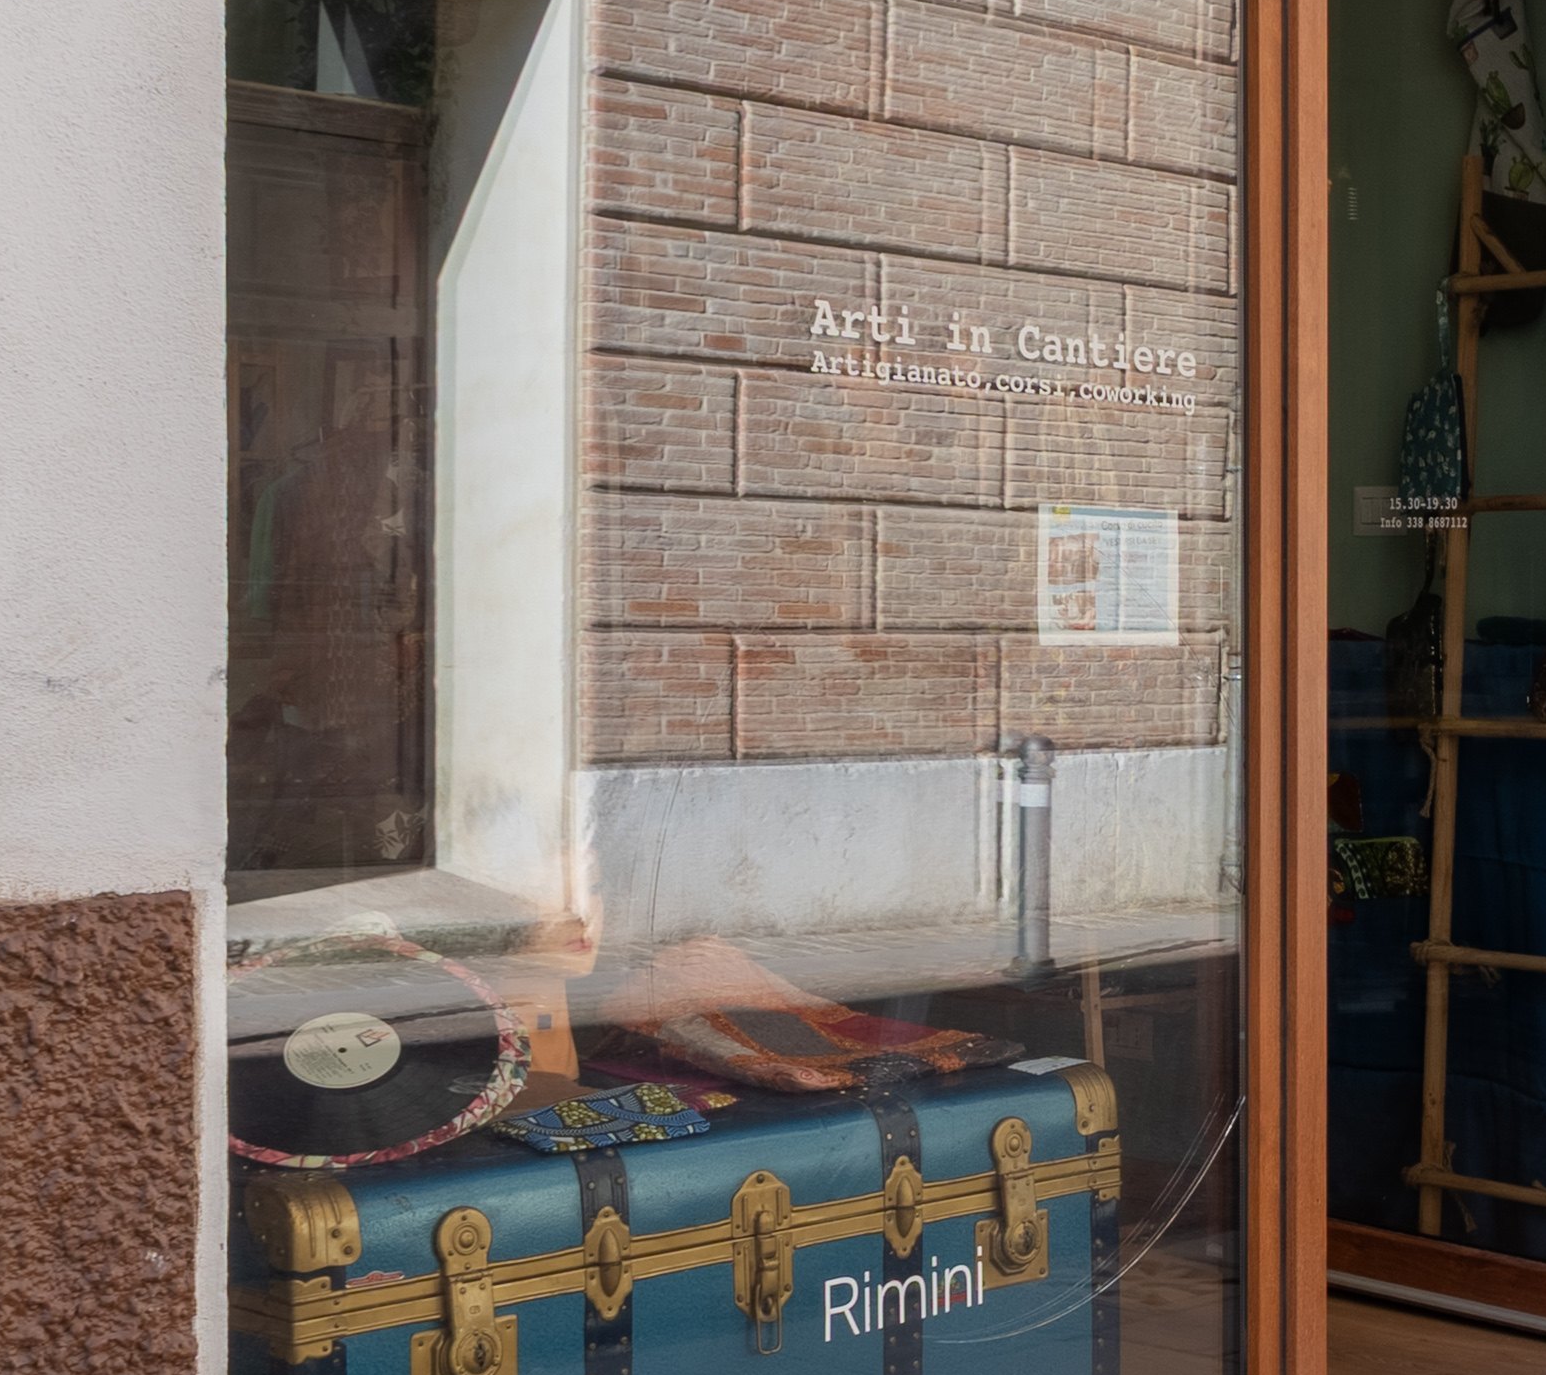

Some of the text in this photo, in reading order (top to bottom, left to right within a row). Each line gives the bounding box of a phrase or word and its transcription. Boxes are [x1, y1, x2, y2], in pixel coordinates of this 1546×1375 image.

[810, 299, 1196, 377] Arti in Cantiere
[1380, 516, 1468, 528] Info 338 8687112
[1389, 497, 1458, 510] 15.30-19.30
[824, 1245, 984, 1343] Rimini
